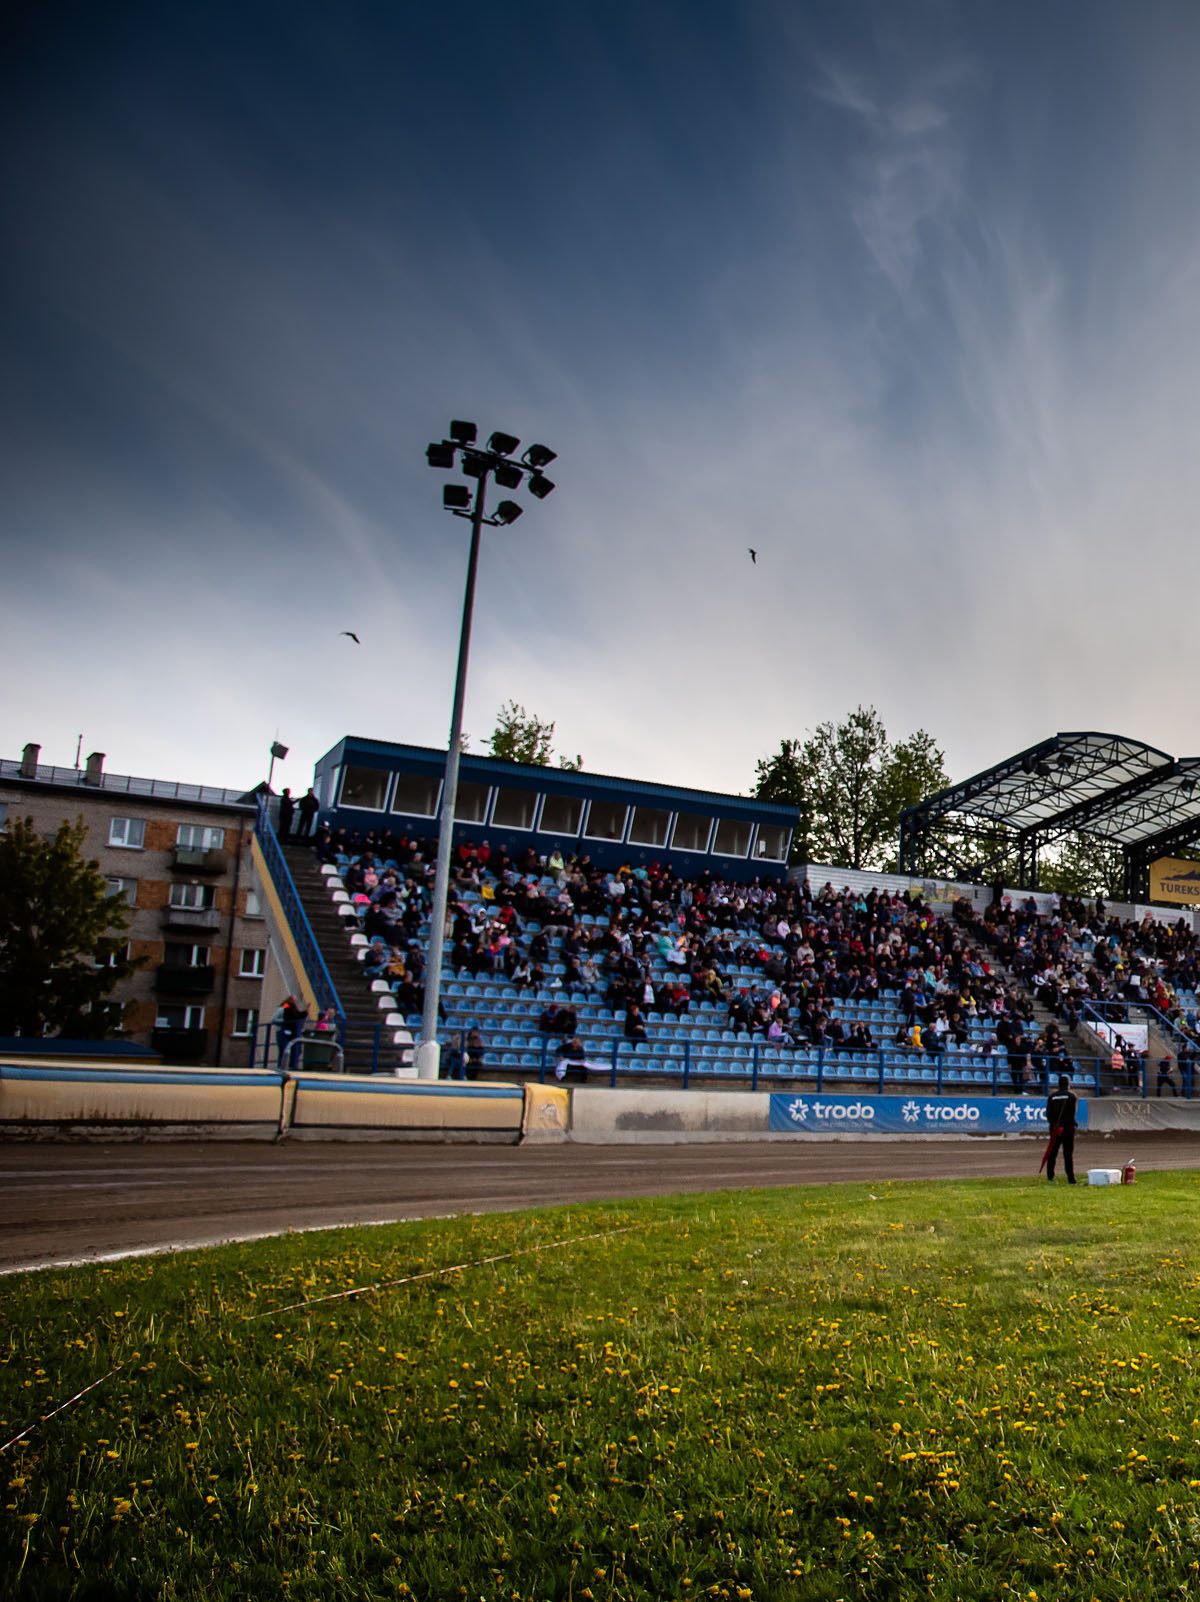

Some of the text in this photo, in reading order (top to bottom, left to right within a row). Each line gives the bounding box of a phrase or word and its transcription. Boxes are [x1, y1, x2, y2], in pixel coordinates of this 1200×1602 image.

[812, 1102, 875, 1119] trodo
[923, 1103, 980, 1120] trodo
[1024, 1105, 1047, 1120] tro
